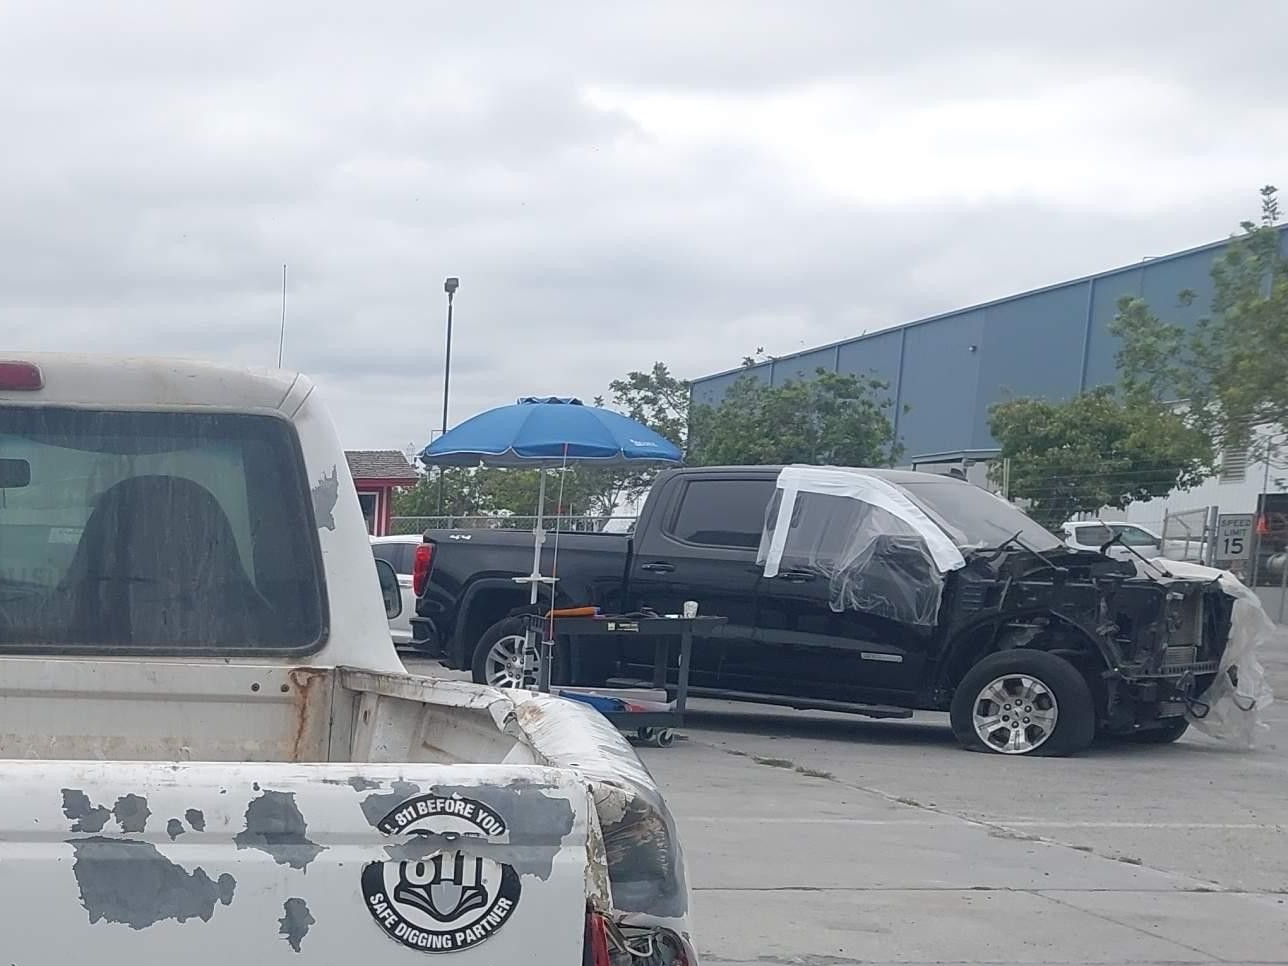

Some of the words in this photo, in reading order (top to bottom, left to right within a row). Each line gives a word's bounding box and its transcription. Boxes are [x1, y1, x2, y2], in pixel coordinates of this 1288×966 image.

[1224, 529, 1247, 537] LIMIT
[1224, 538, 1244, 554] 15
[395, 806, 416, 825] 811
[417, 799, 475, 817] BEFORE
[476, 809, 503, 836] YOU
[370, 893, 399, 928] SAFE
[394, 923, 452, 949] DIGGING
[455, 897, 513, 946] PARTNER
